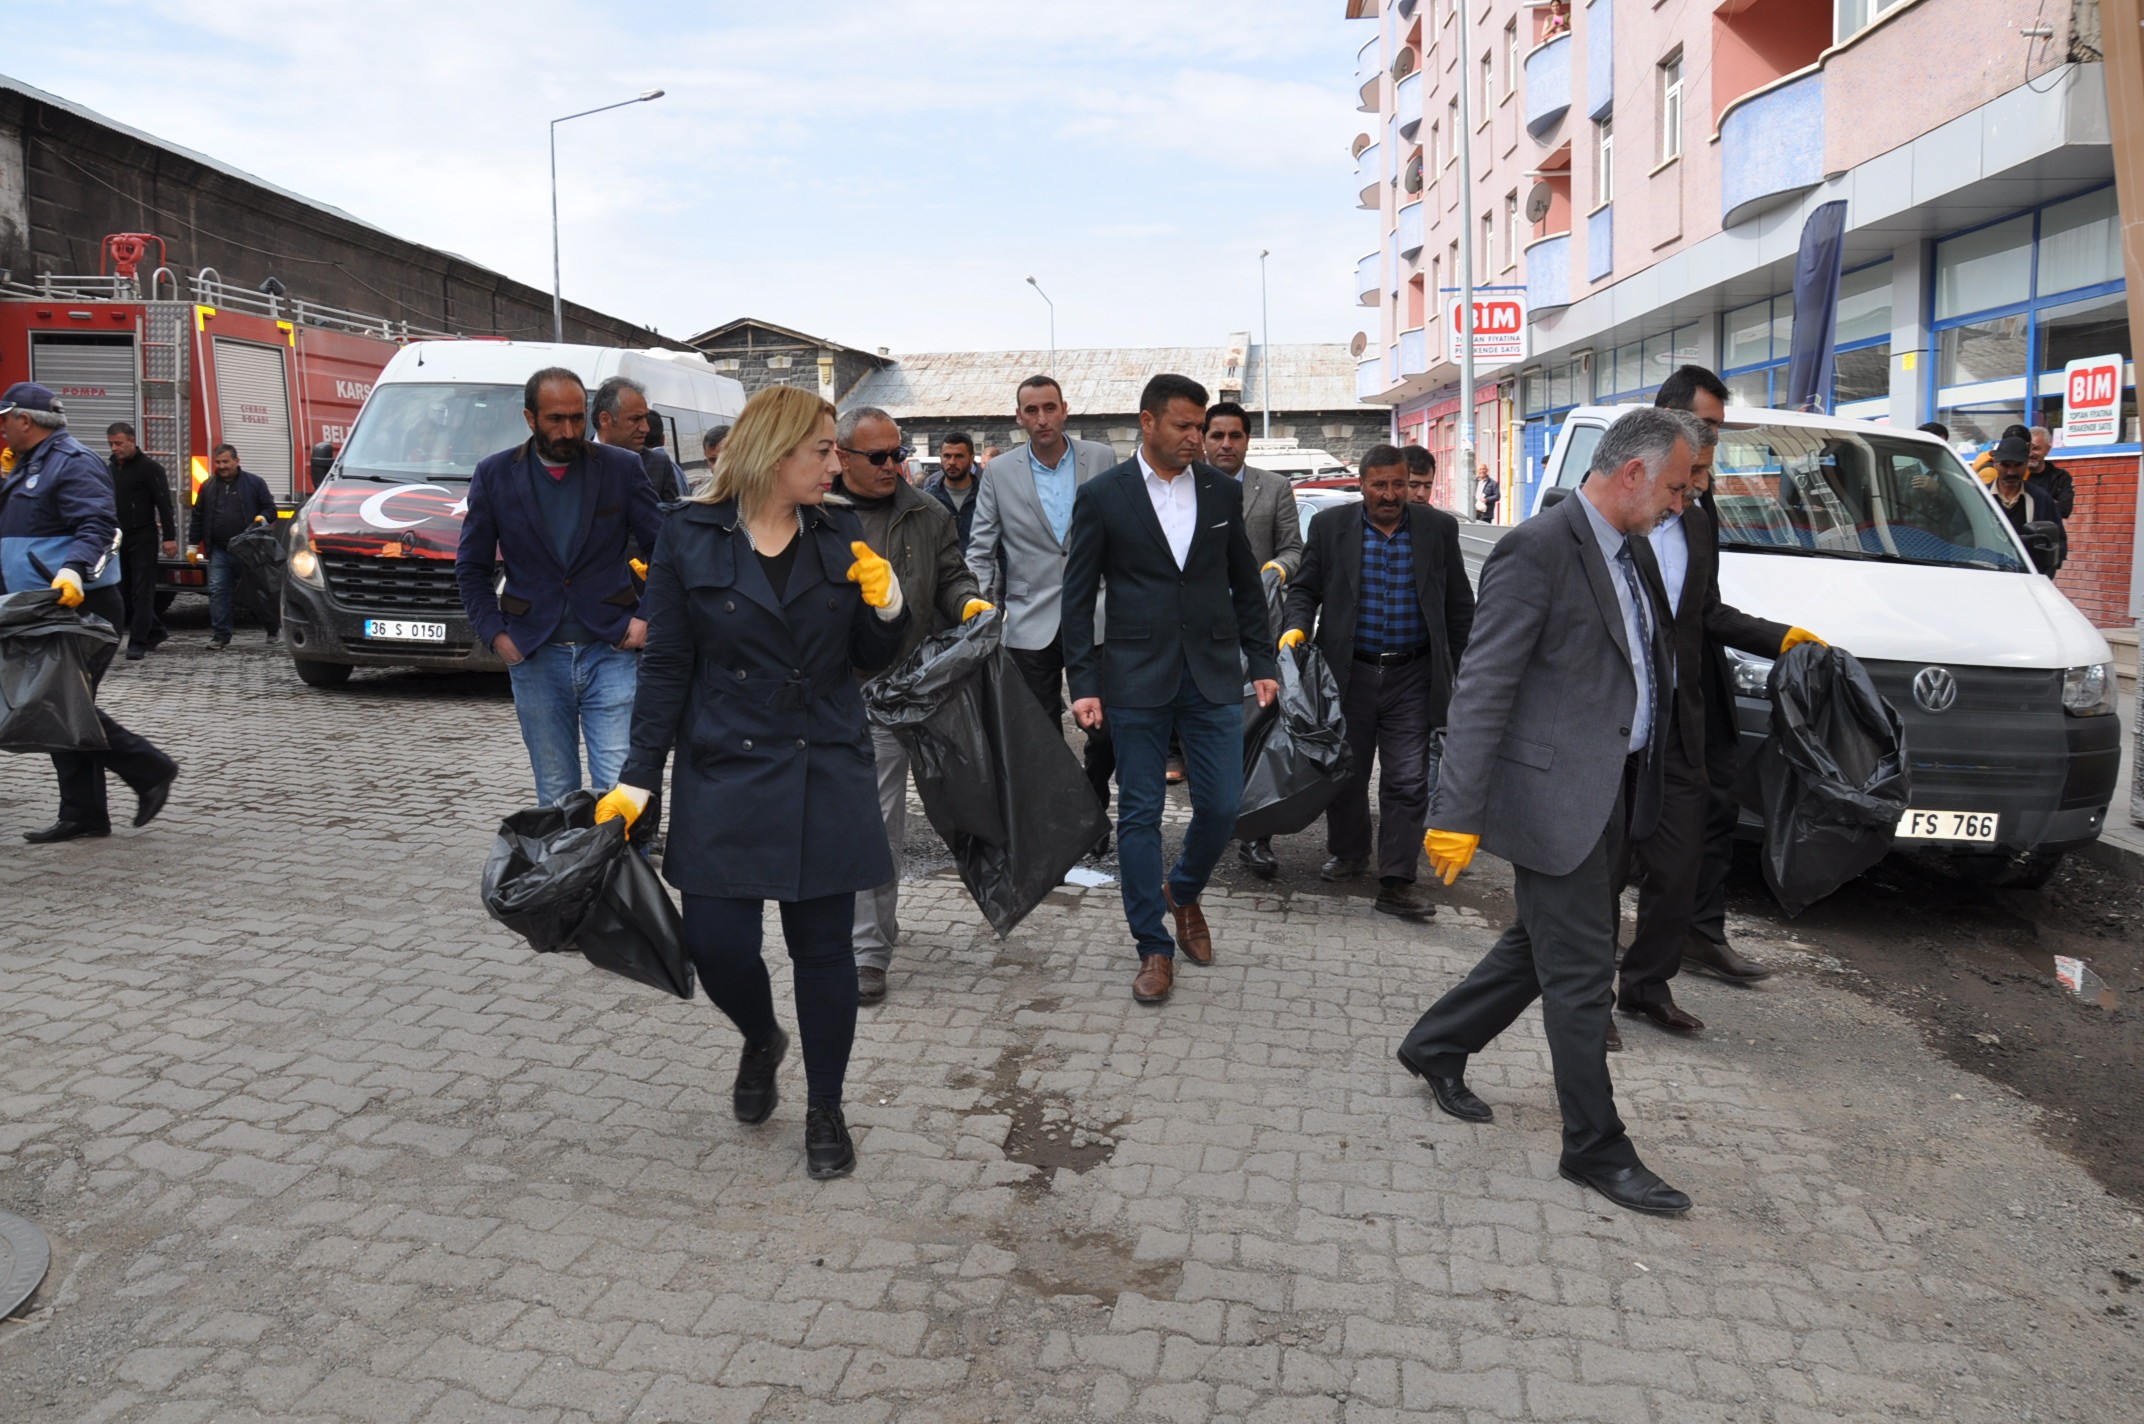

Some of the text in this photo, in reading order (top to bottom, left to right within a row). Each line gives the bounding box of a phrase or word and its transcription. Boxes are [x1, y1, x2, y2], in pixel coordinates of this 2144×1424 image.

[62, 387, 106, 397] POMPA
[371, 622, 443, 638] 36 S 0150
[1911, 812, 1993, 838] FS 766
